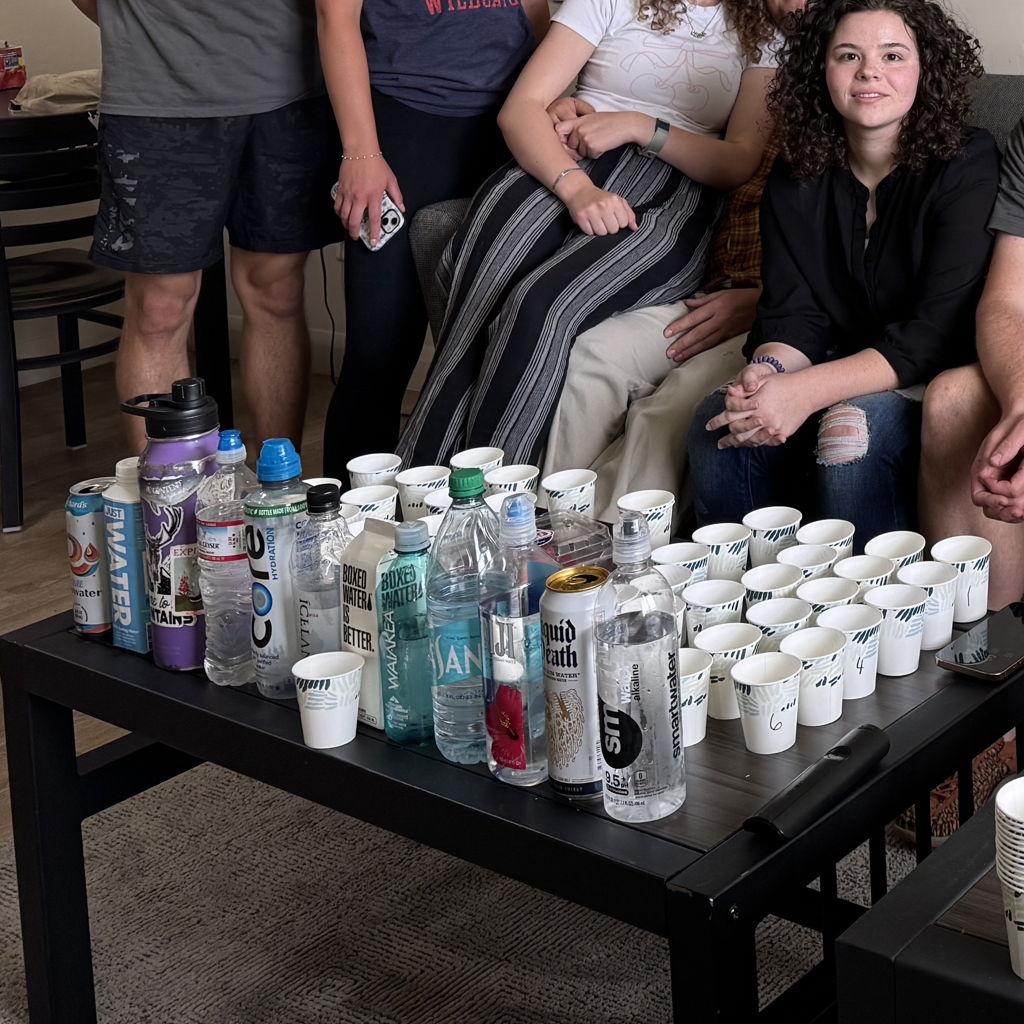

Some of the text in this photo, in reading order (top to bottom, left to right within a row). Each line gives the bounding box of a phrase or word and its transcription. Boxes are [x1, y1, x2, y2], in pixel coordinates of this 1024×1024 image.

[106, 519, 132, 626] WATER
[266, 527, 278, 581] HYDRATION
[246, 525, 273, 649] core
[343, 563, 367, 589] BOXED
[343, 584, 367, 611] WATER
[343, 604, 350, 623] IS
[343, 624, 375, 653] BETTER.
[384, 610, 400, 690] WAIAKEA
[631, 663, 641, 702] alkaline
[666, 652, 681, 759] smartwater
[769, 712, 783, 731] 6
